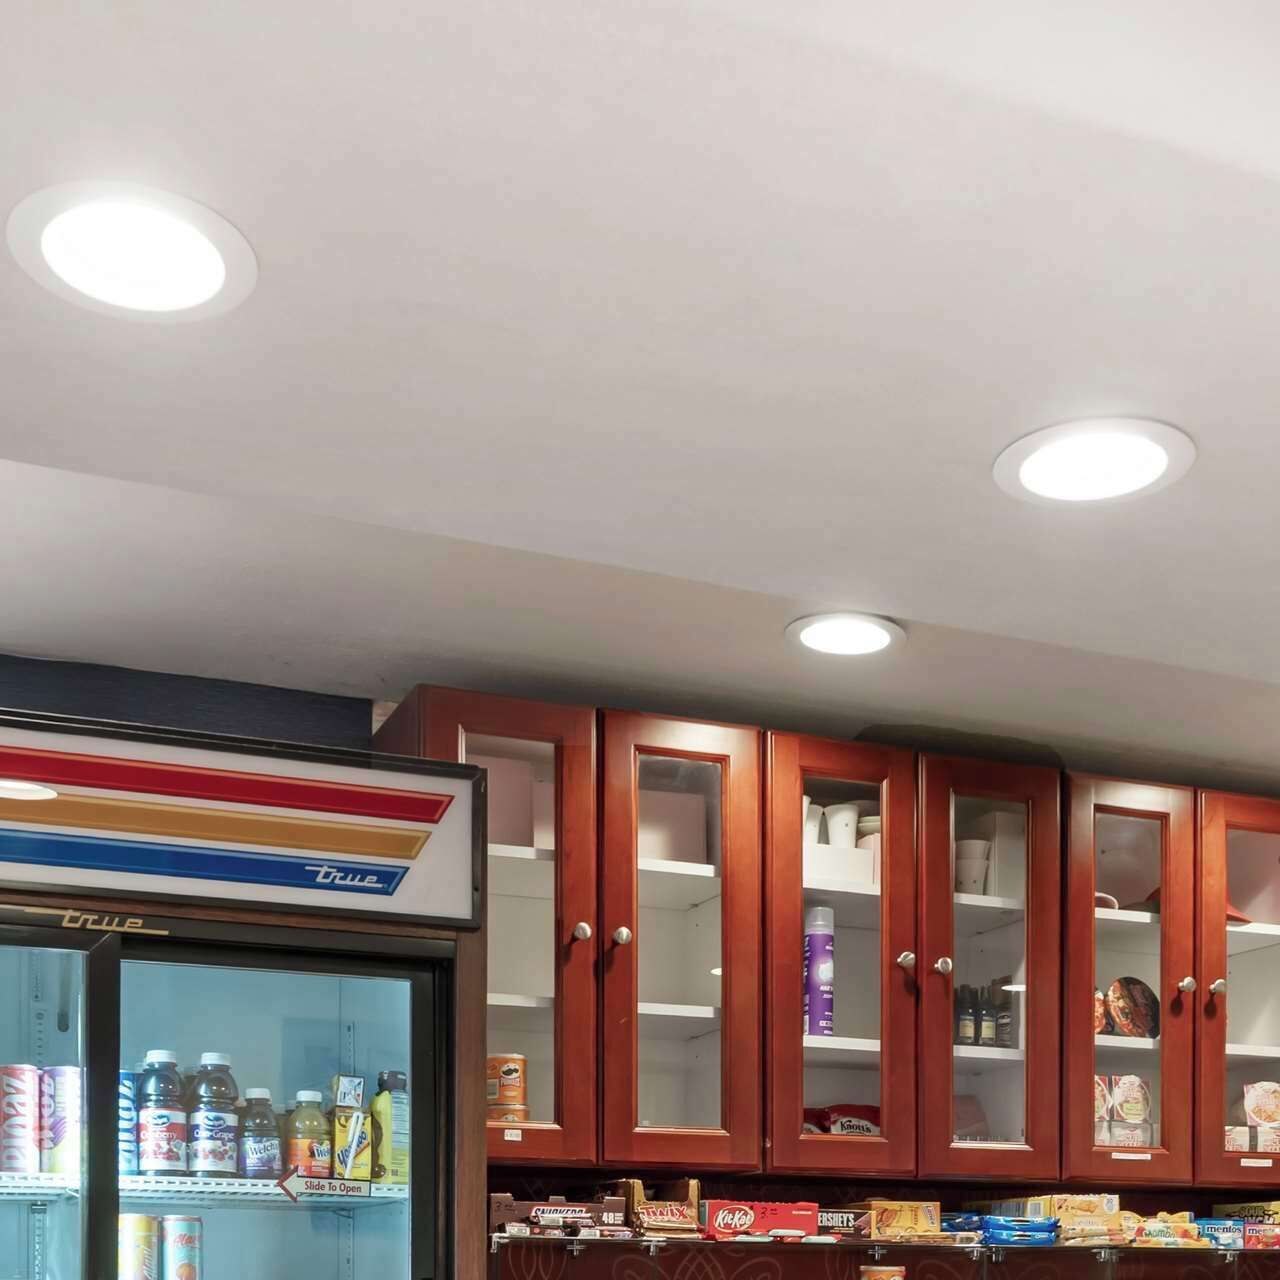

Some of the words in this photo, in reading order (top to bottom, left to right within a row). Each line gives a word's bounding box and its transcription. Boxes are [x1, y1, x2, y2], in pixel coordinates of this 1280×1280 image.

[306, 865, 384, 889] true
[304, 1180, 326, 1191] Slide
[327, 1181, 337, 1192] To
[338, 1182, 362, 1194] Open
[1239, 1206, 1264, 1217] SOUR
[818, 1212, 855, 1227] ERSHEY'S
[1206, 1224, 1242, 1235] mentos
